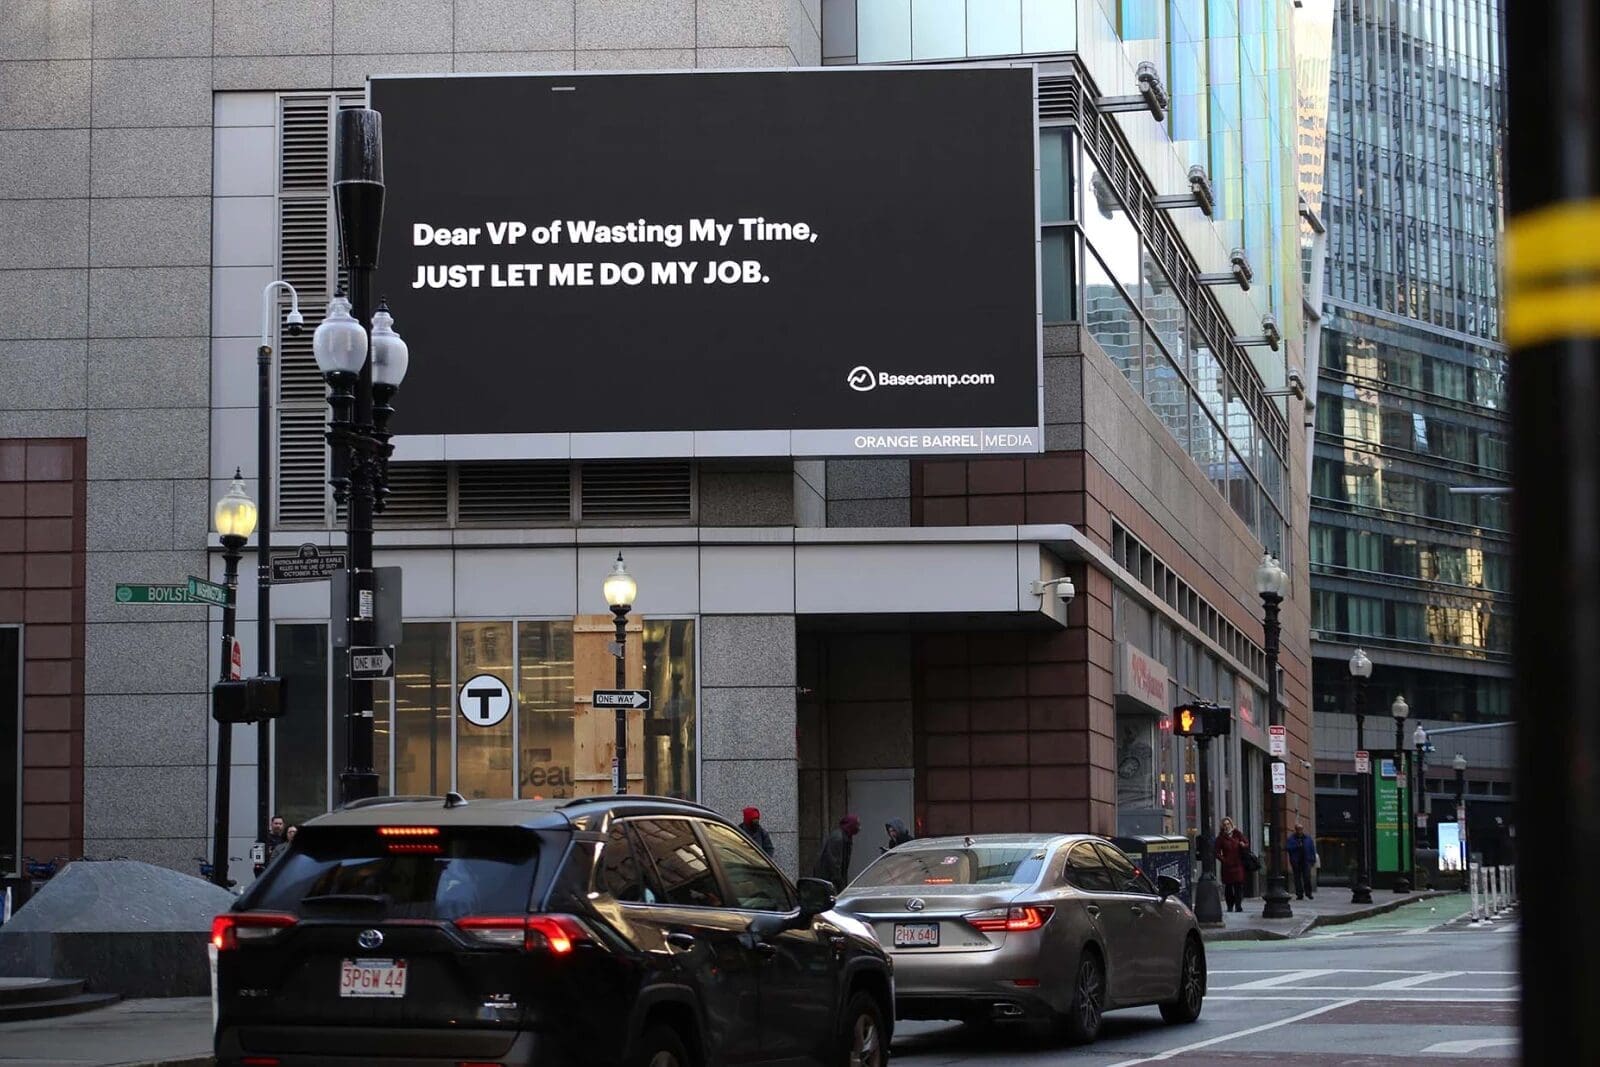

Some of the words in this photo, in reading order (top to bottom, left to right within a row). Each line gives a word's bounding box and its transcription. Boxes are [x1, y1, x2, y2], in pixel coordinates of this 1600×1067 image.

[412, 223, 481, 246] Dear
[486, 221, 527, 245] VP
[532, 219, 563, 244] of
[567, 218, 683, 248] Wasting
[689, 217, 733, 248] My
[738, 216, 819, 245] Time,
[411, 264, 486, 289] JUST
[491, 263, 543, 288] LET
[549, 262, 594, 287] ME
[600, 261, 646, 286] DO
[651, 261, 699, 286] MY
[703, 260, 770, 286] JOB.
[879, 371, 995, 388] Basecamp.com
[854, 435, 918, 449] ORANGE
[923, 434, 978, 448] BARREL
[985, 434, 1033, 447] MEDIA
[354, 657, 368, 669] ONE
[371, 656, 383, 668] WAY
[467, 688, 502, 719] T
[598, 695, 614, 703] ONE
[618, 695, 634, 703] WAY
[896, 929, 915, 941] 2HX
[918, 929, 936, 941] 640
[342, 968, 380, 988] 3PGW
[384, 969, 404, 988] 44
